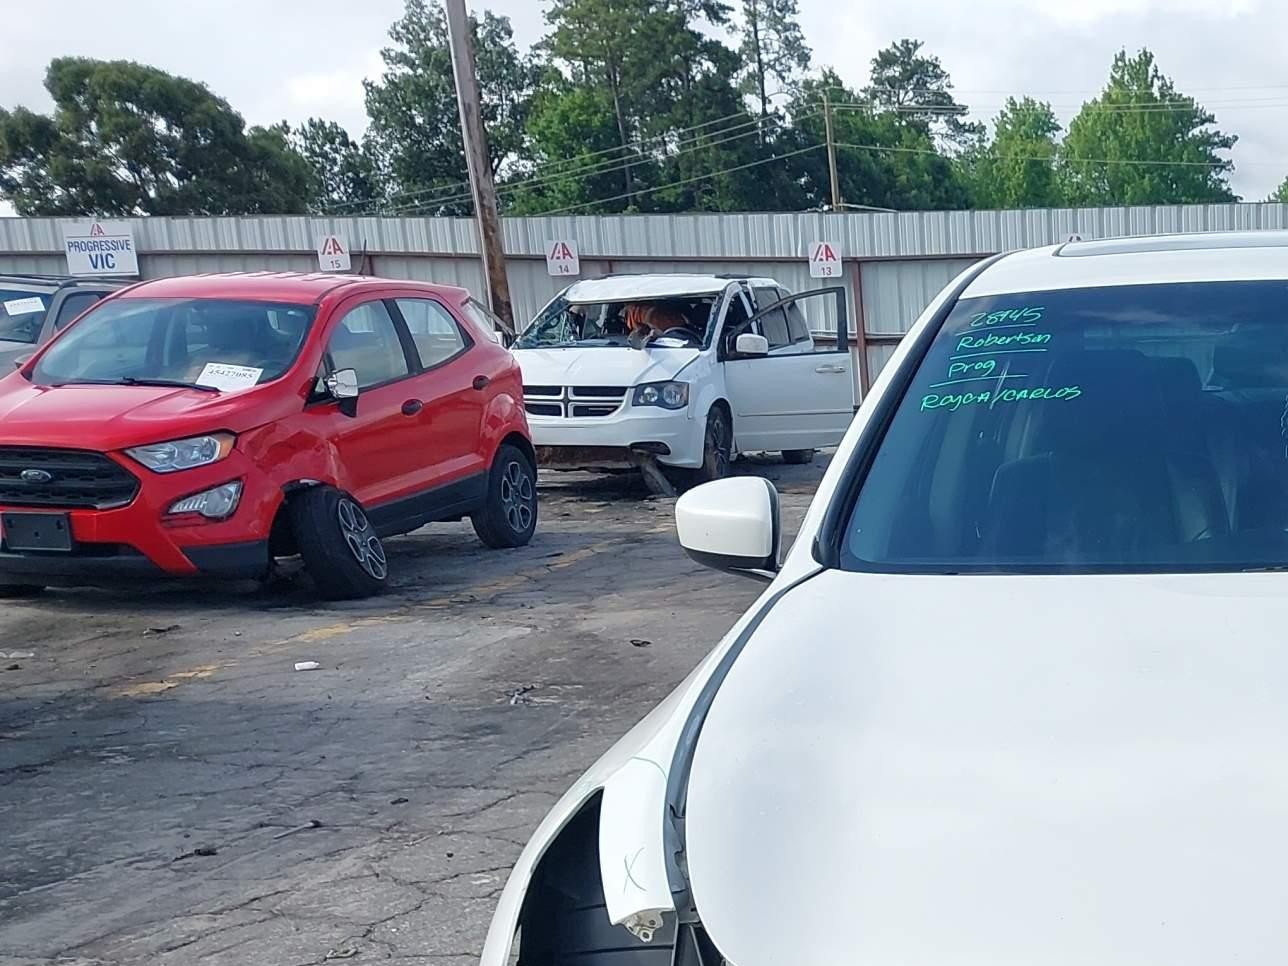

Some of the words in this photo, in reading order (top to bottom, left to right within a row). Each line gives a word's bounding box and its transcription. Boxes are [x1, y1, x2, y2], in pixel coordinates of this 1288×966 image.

[67, 239, 132, 252] PROGRESSIVE
[89, 253, 116, 270] VIC
[330, 259, 341, 269] 15
[558, 264, 570, 274] 14
[820, 266, 832, 276] 13
[956, 332, 1052, 351] Robertson
